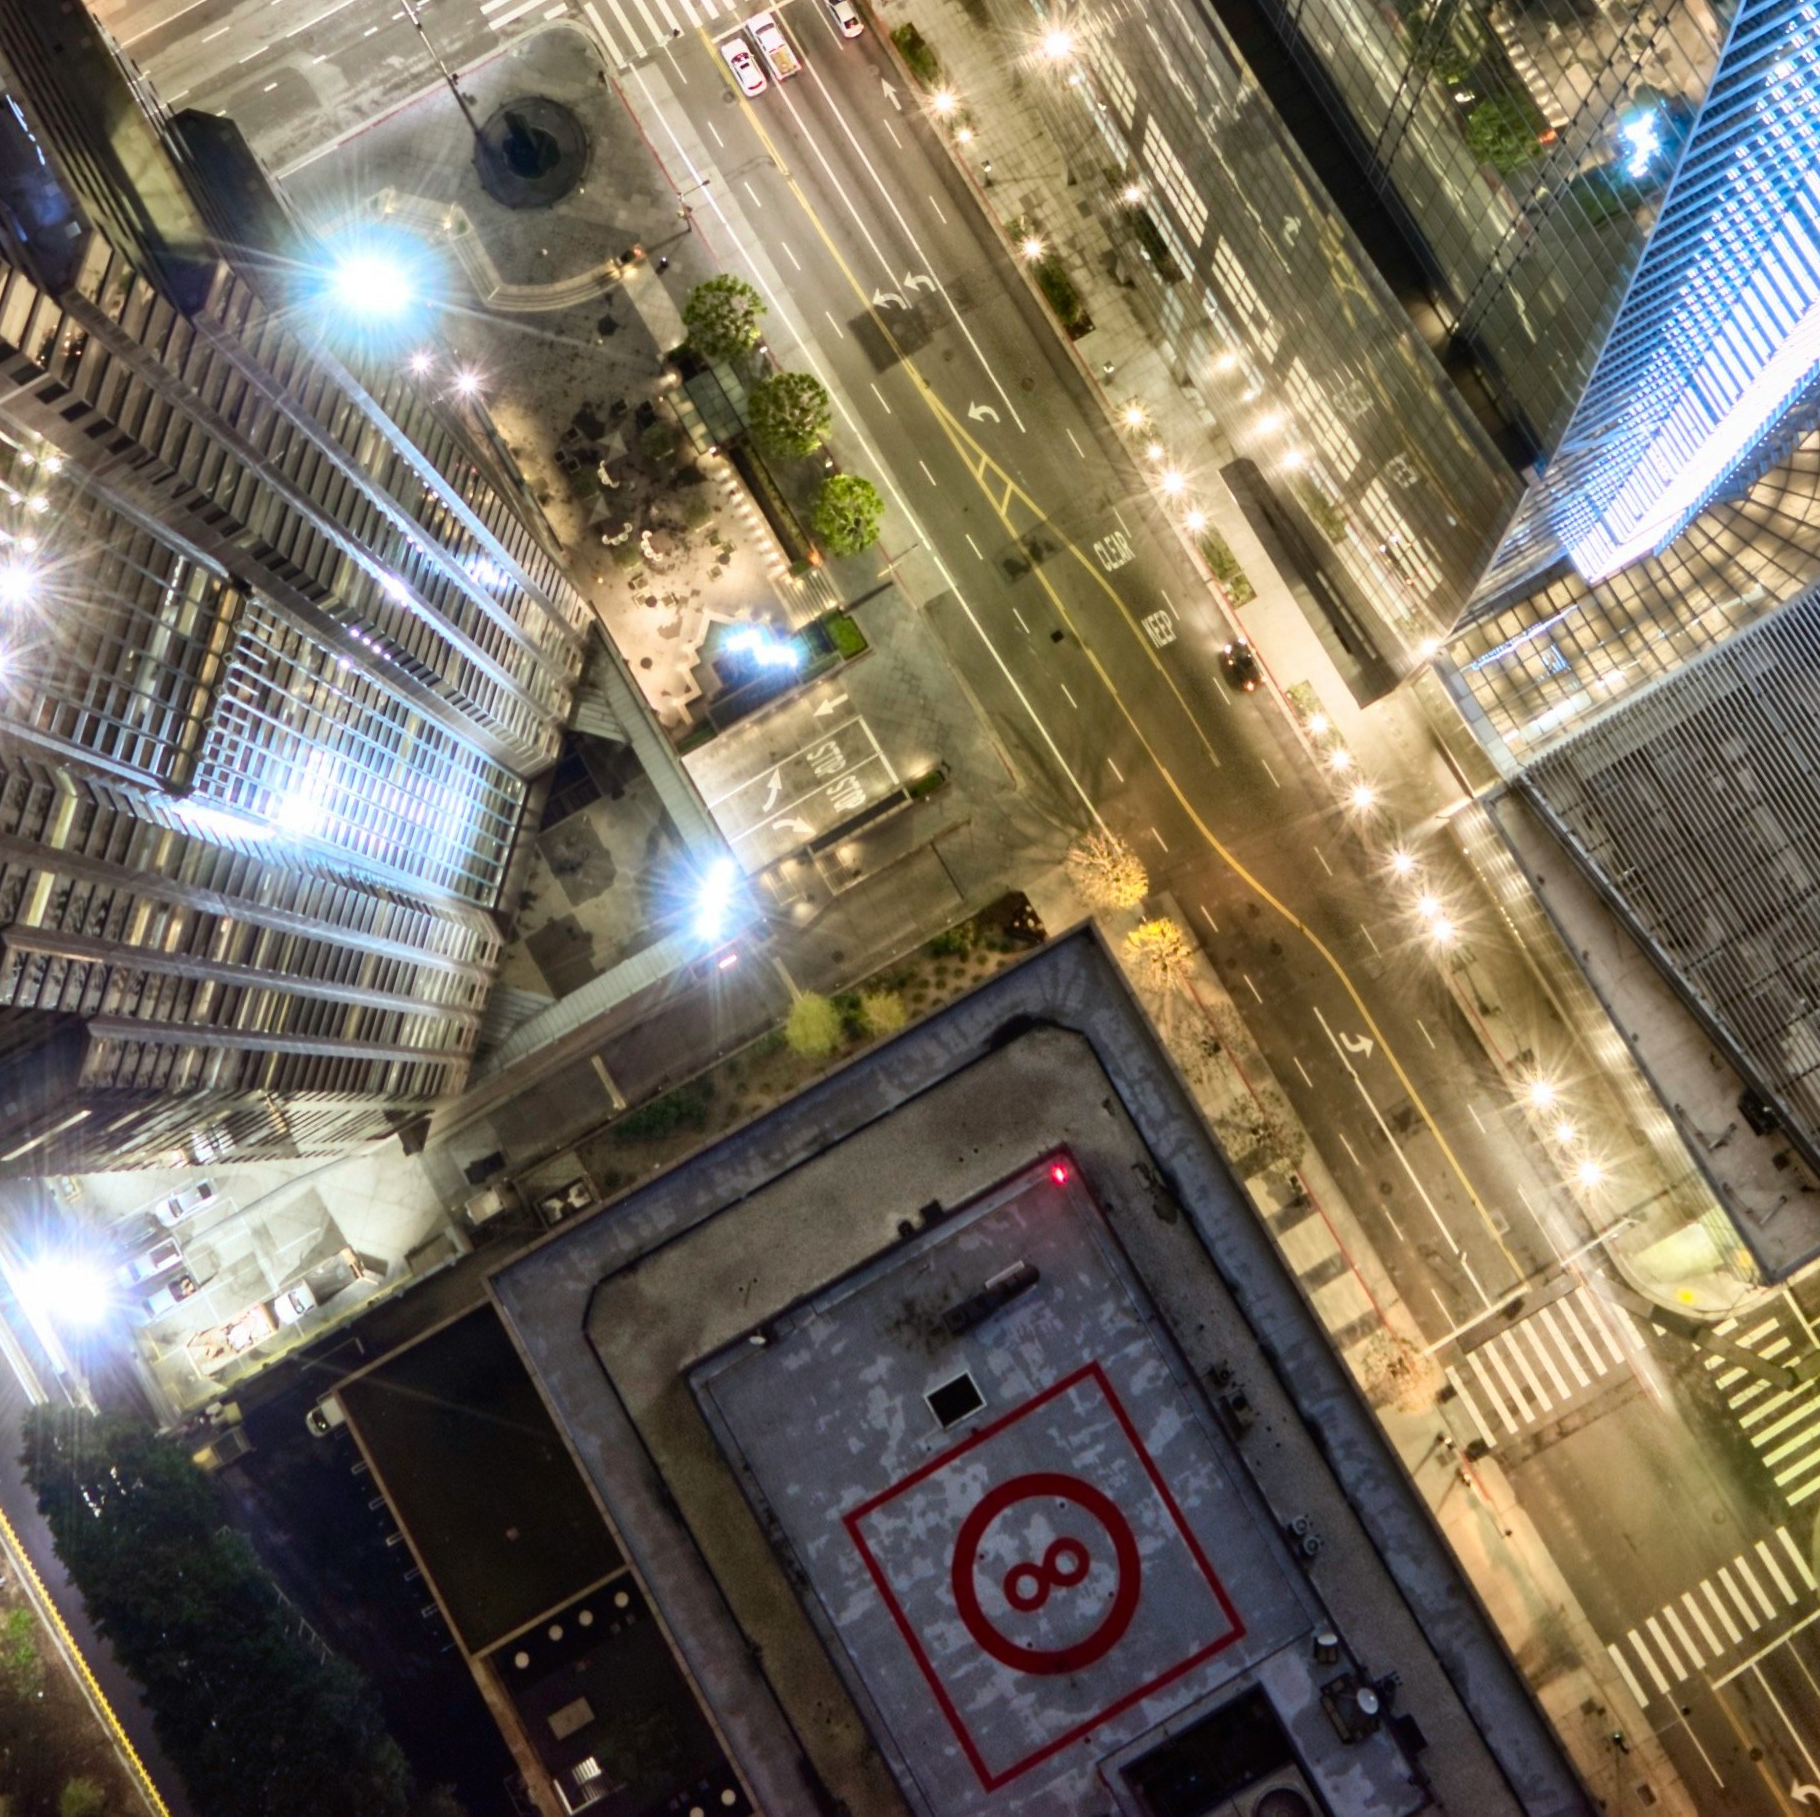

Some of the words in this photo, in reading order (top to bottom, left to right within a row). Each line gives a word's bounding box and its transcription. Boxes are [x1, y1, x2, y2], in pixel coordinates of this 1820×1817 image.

[1093, 530, 1136, 572] CLEAR
[1141, 610, 1177, 649] KEEP
[806, 740, 846, 778] STOP
[826, 775, 867, 813] STOP
[1003, 1535, 1091, 1615] 8
